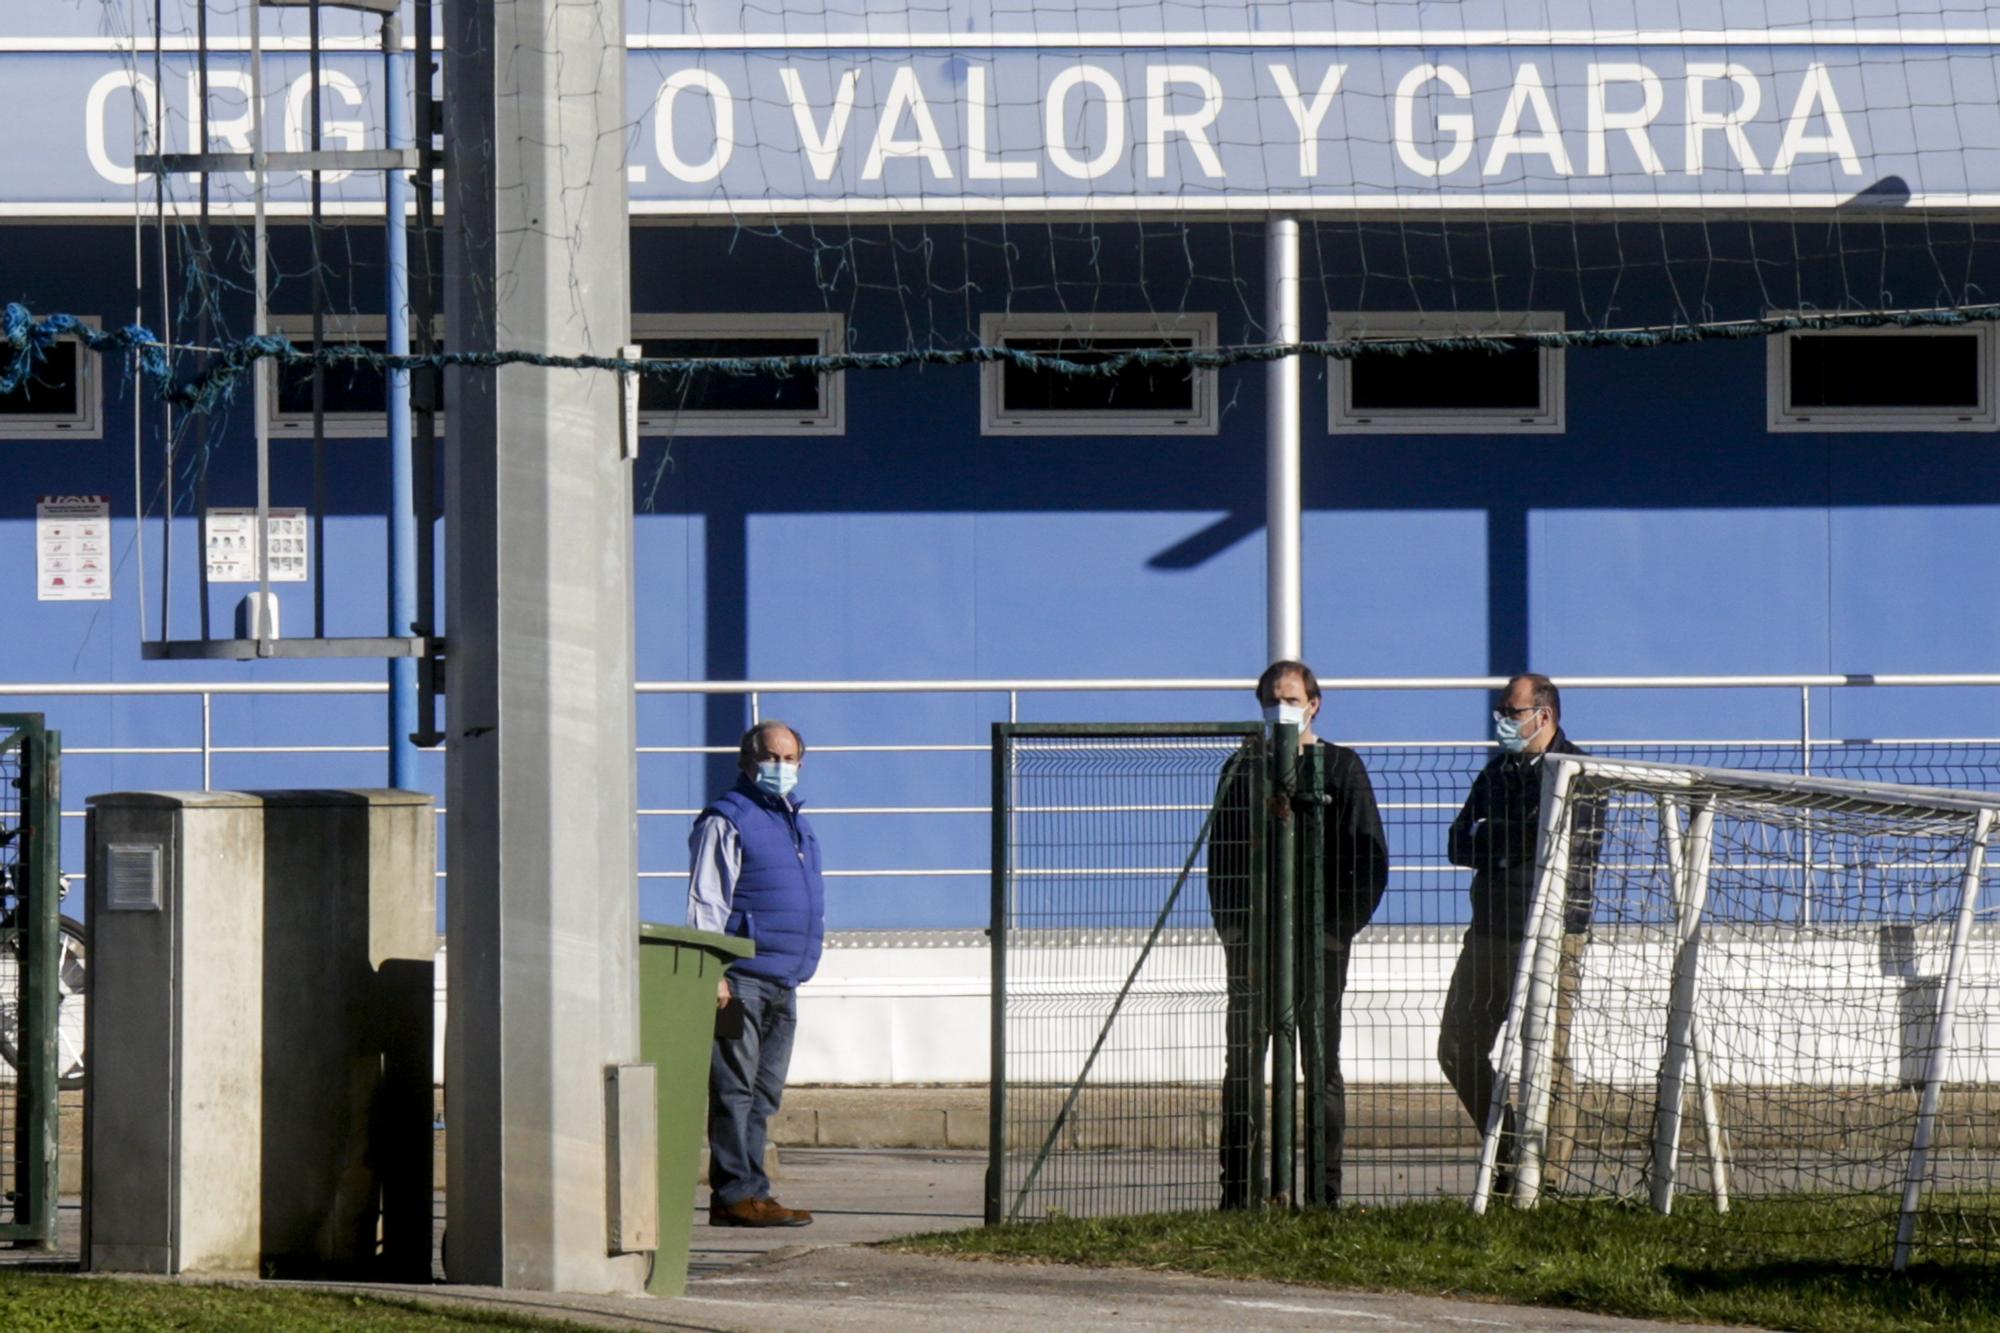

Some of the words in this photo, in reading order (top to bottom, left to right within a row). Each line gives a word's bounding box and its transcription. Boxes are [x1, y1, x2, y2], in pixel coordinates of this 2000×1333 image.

[85, 68, 734, 185] ORGO
[778, 64, 1226, 182] VALOR
[1268, 63, 1348, 177] Y
[1394, 61, 1863, 177] GARRA
